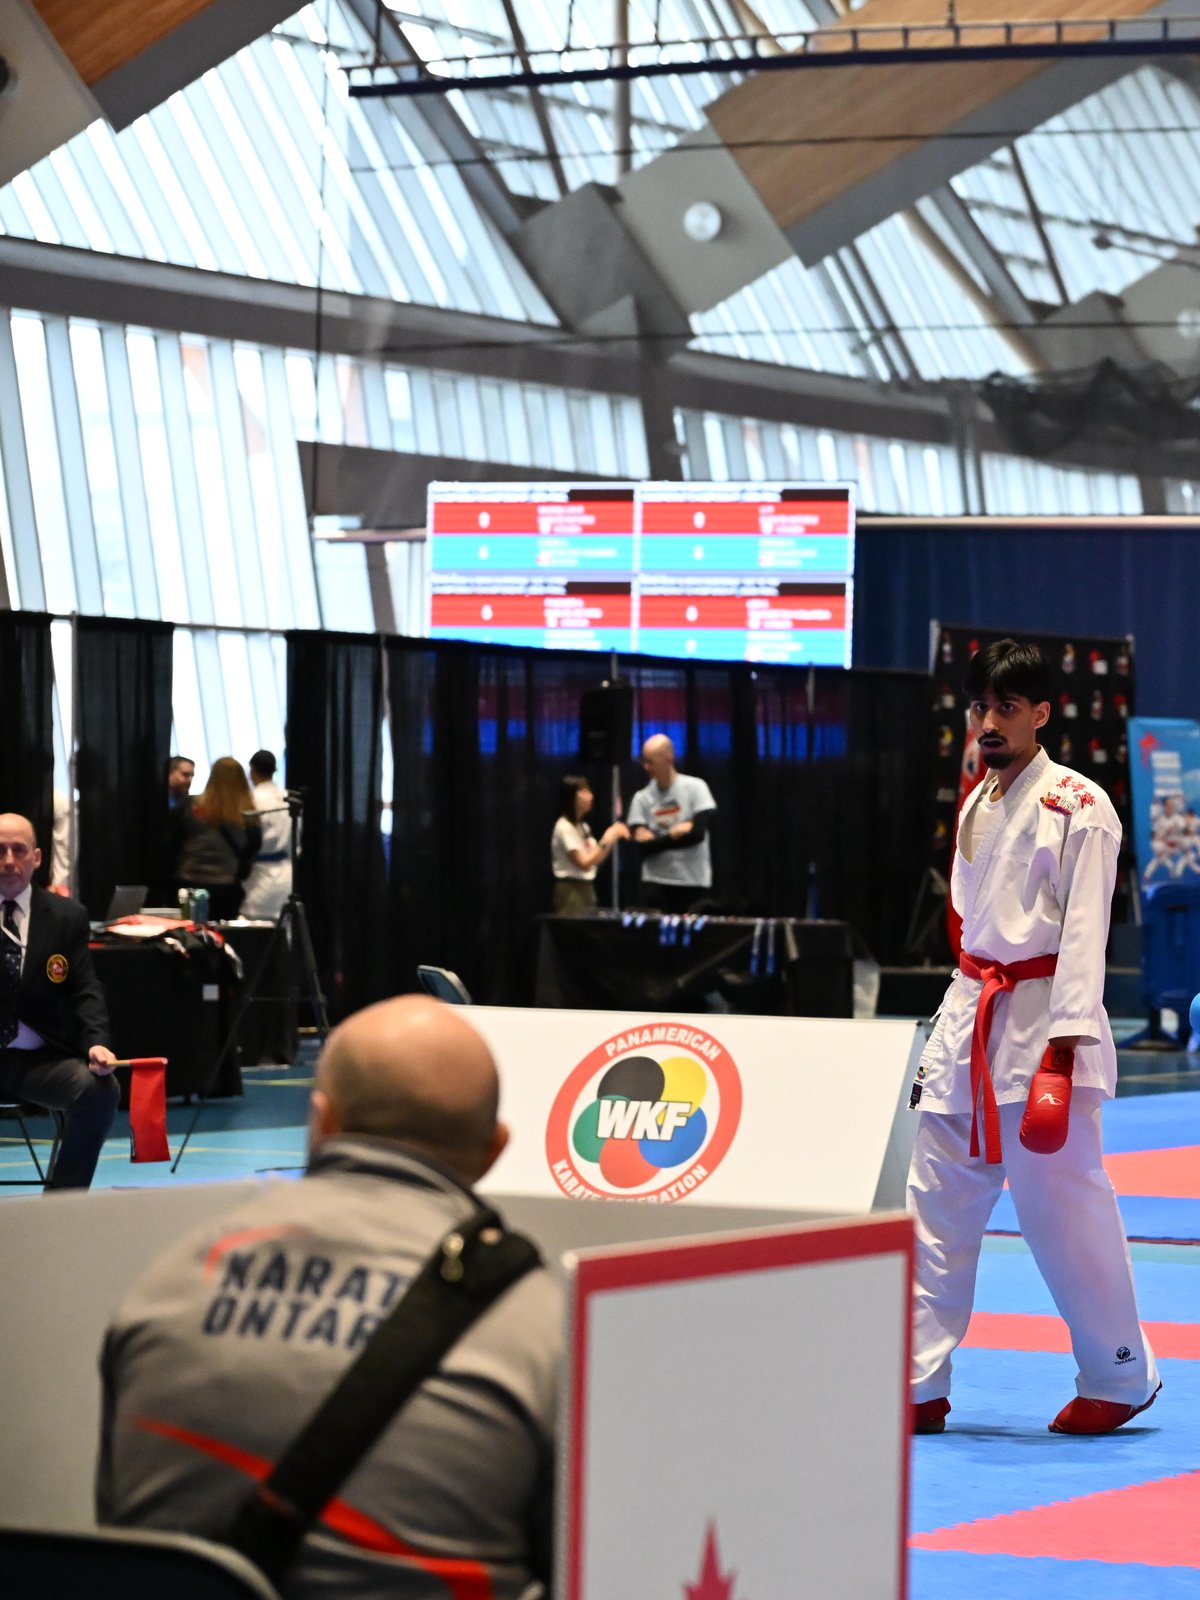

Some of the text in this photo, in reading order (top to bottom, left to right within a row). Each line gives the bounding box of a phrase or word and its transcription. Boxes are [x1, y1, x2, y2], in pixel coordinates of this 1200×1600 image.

[604, 1026, 722, 1062] PANAMERICAN
[596, 1099, 693, 1141] WKF
[222, 1249, 407, 1307] KARAT
[203, 1297, 385, 1350] ONTAR
